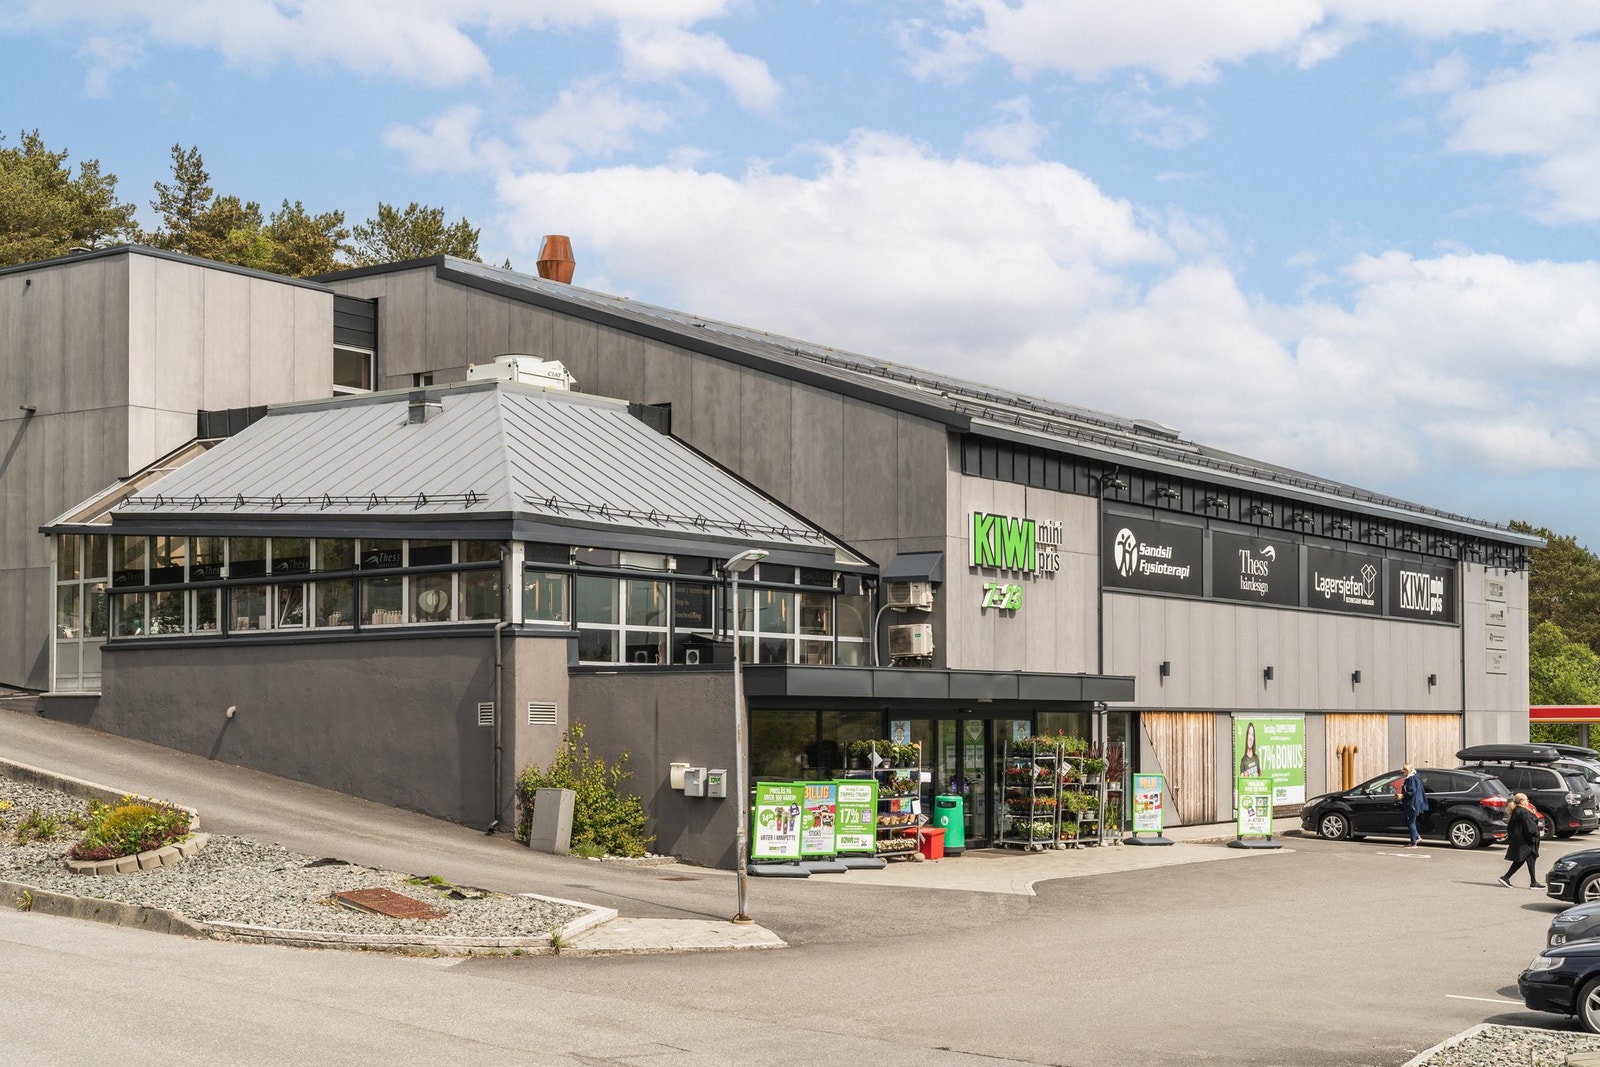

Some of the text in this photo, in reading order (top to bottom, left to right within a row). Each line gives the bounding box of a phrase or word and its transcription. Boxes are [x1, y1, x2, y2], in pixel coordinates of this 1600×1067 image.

[971, 511, 1036, 573] KIWI
[1038, 520, 1062, 545] mini
[379, 552, 401, 563] Thess
[1037, 546, 1060, 575] pris
[1139, 542, 1173, 559] Sandsli
[1238, 549, 1269, 577] Thess
[205, 566, 221, 576] Thes
[1139, 559, 1191, 580] Fysioterapi
[1314, 571, 1363, 602] Lagersjefen
[1400, 570, 1430, 611] KIWI
[1258, 744, 1275, 771] 17%
[1275, 743, 1303, 770] BONUS
[805, 786, 829, 799] BILLIG
